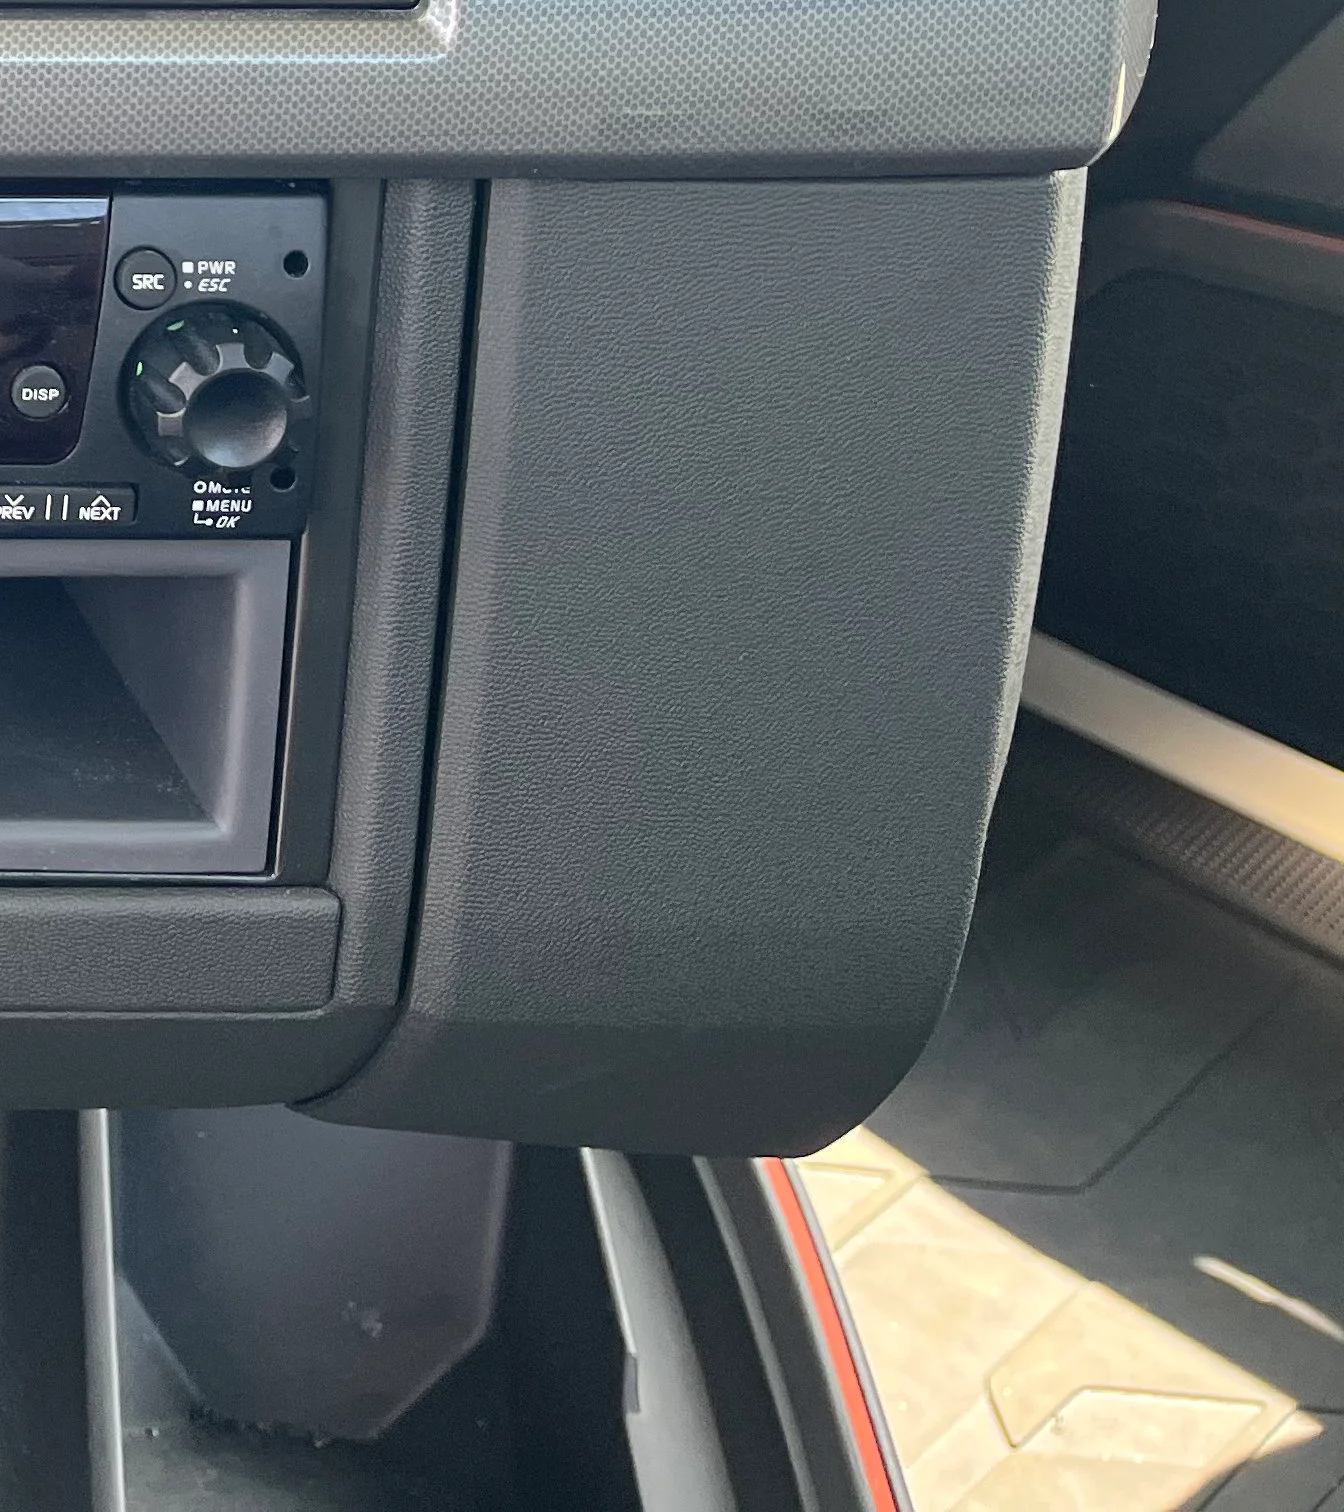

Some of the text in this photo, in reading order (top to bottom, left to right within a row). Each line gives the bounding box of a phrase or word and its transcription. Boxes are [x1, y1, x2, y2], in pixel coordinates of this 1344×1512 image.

[197, 261, 236, 275] PWR
[132, 274, 165, 290] SRC
[197, 278, 231, 292] ESC
[21, 387, 60, 401] DISP
[205, 499, 252, 512] MENU
[79, 506, 121, 521] NEXT
[215, 515, 241, 529] OK
